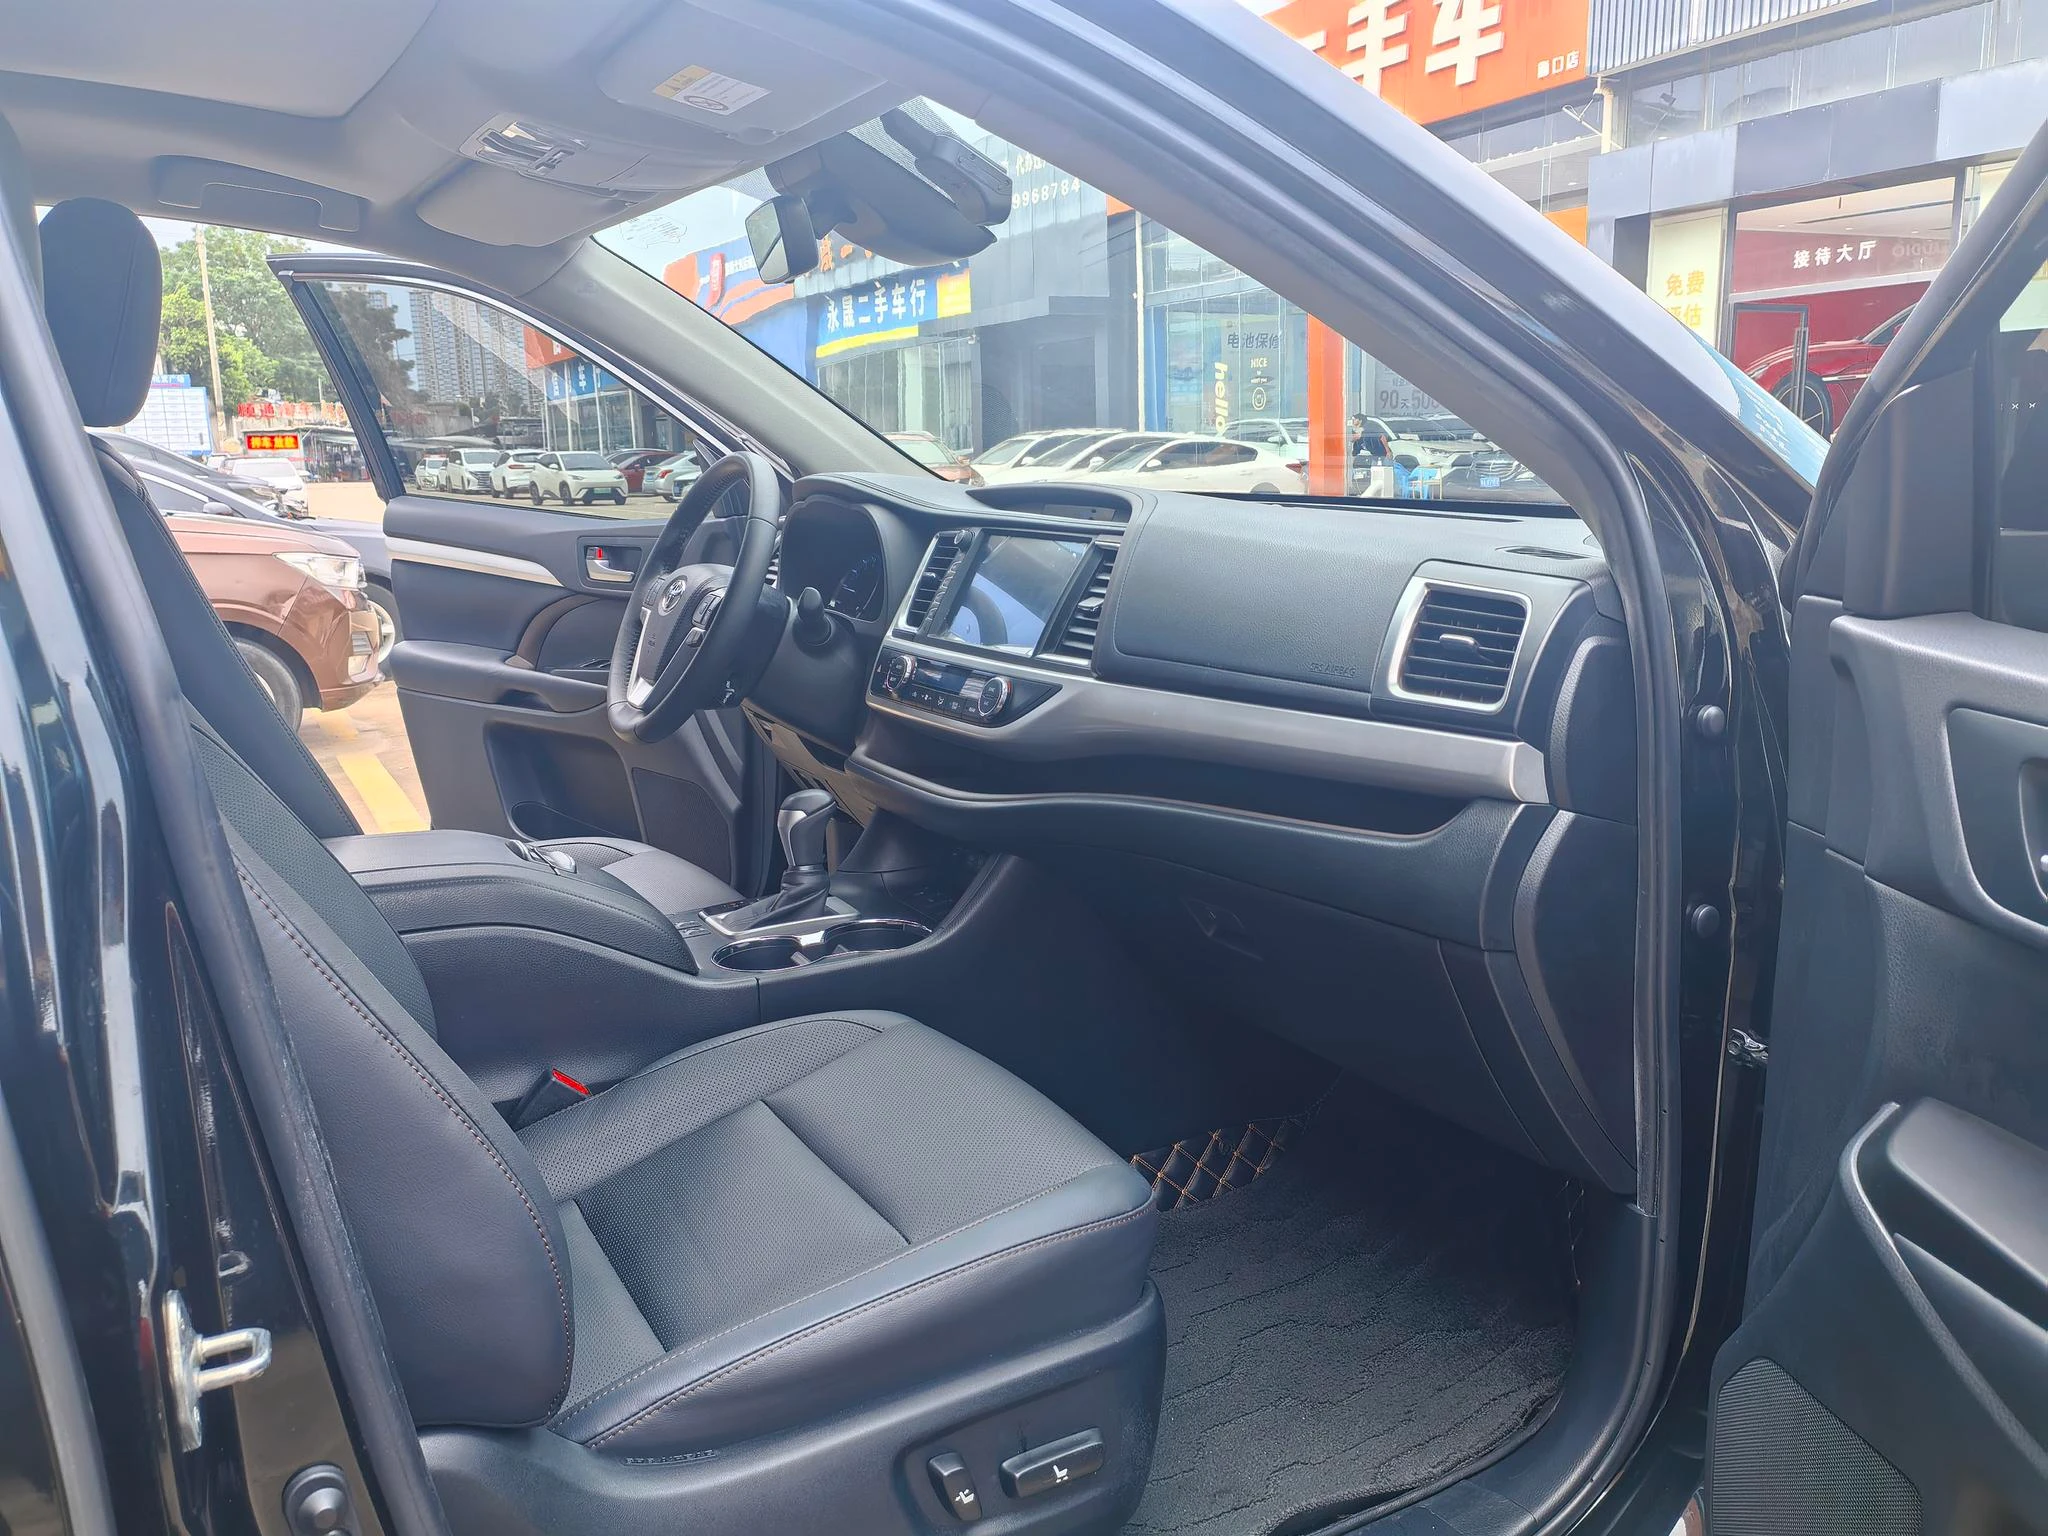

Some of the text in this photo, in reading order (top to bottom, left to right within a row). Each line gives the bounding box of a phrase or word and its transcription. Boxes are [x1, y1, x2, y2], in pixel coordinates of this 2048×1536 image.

[1300, 0, 1504, 97] 手车
[1793, 239, 1878, 269] 接待大厅
[1666, 270, 1705, 297] 免费
[1228, 331, 1280, 349] 电池保修
[1214, 361, 1229, 433] hello
